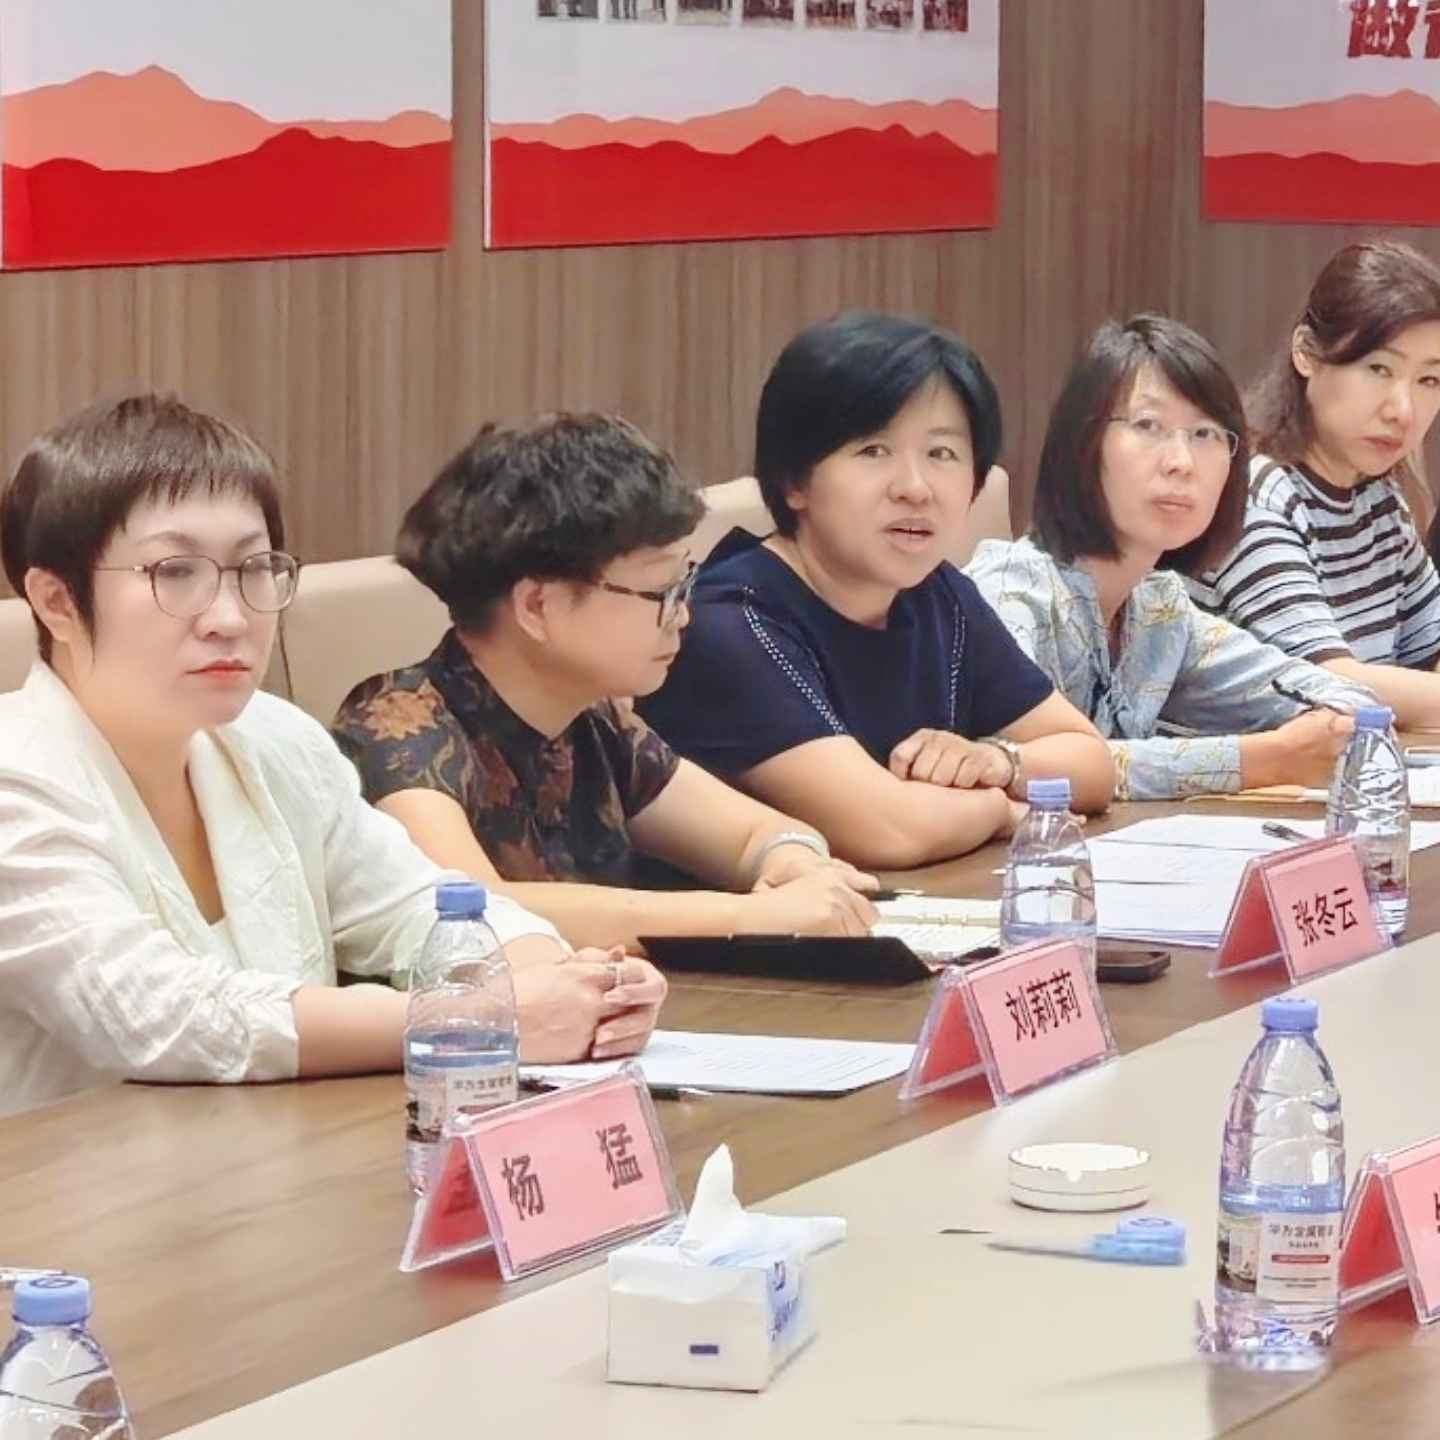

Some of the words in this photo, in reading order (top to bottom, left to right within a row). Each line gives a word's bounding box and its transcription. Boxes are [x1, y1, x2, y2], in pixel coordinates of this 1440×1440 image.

[1292, 887, 1359, 947] 张冬云
[1005, 968, 1082, 1042] 刘莉莉
